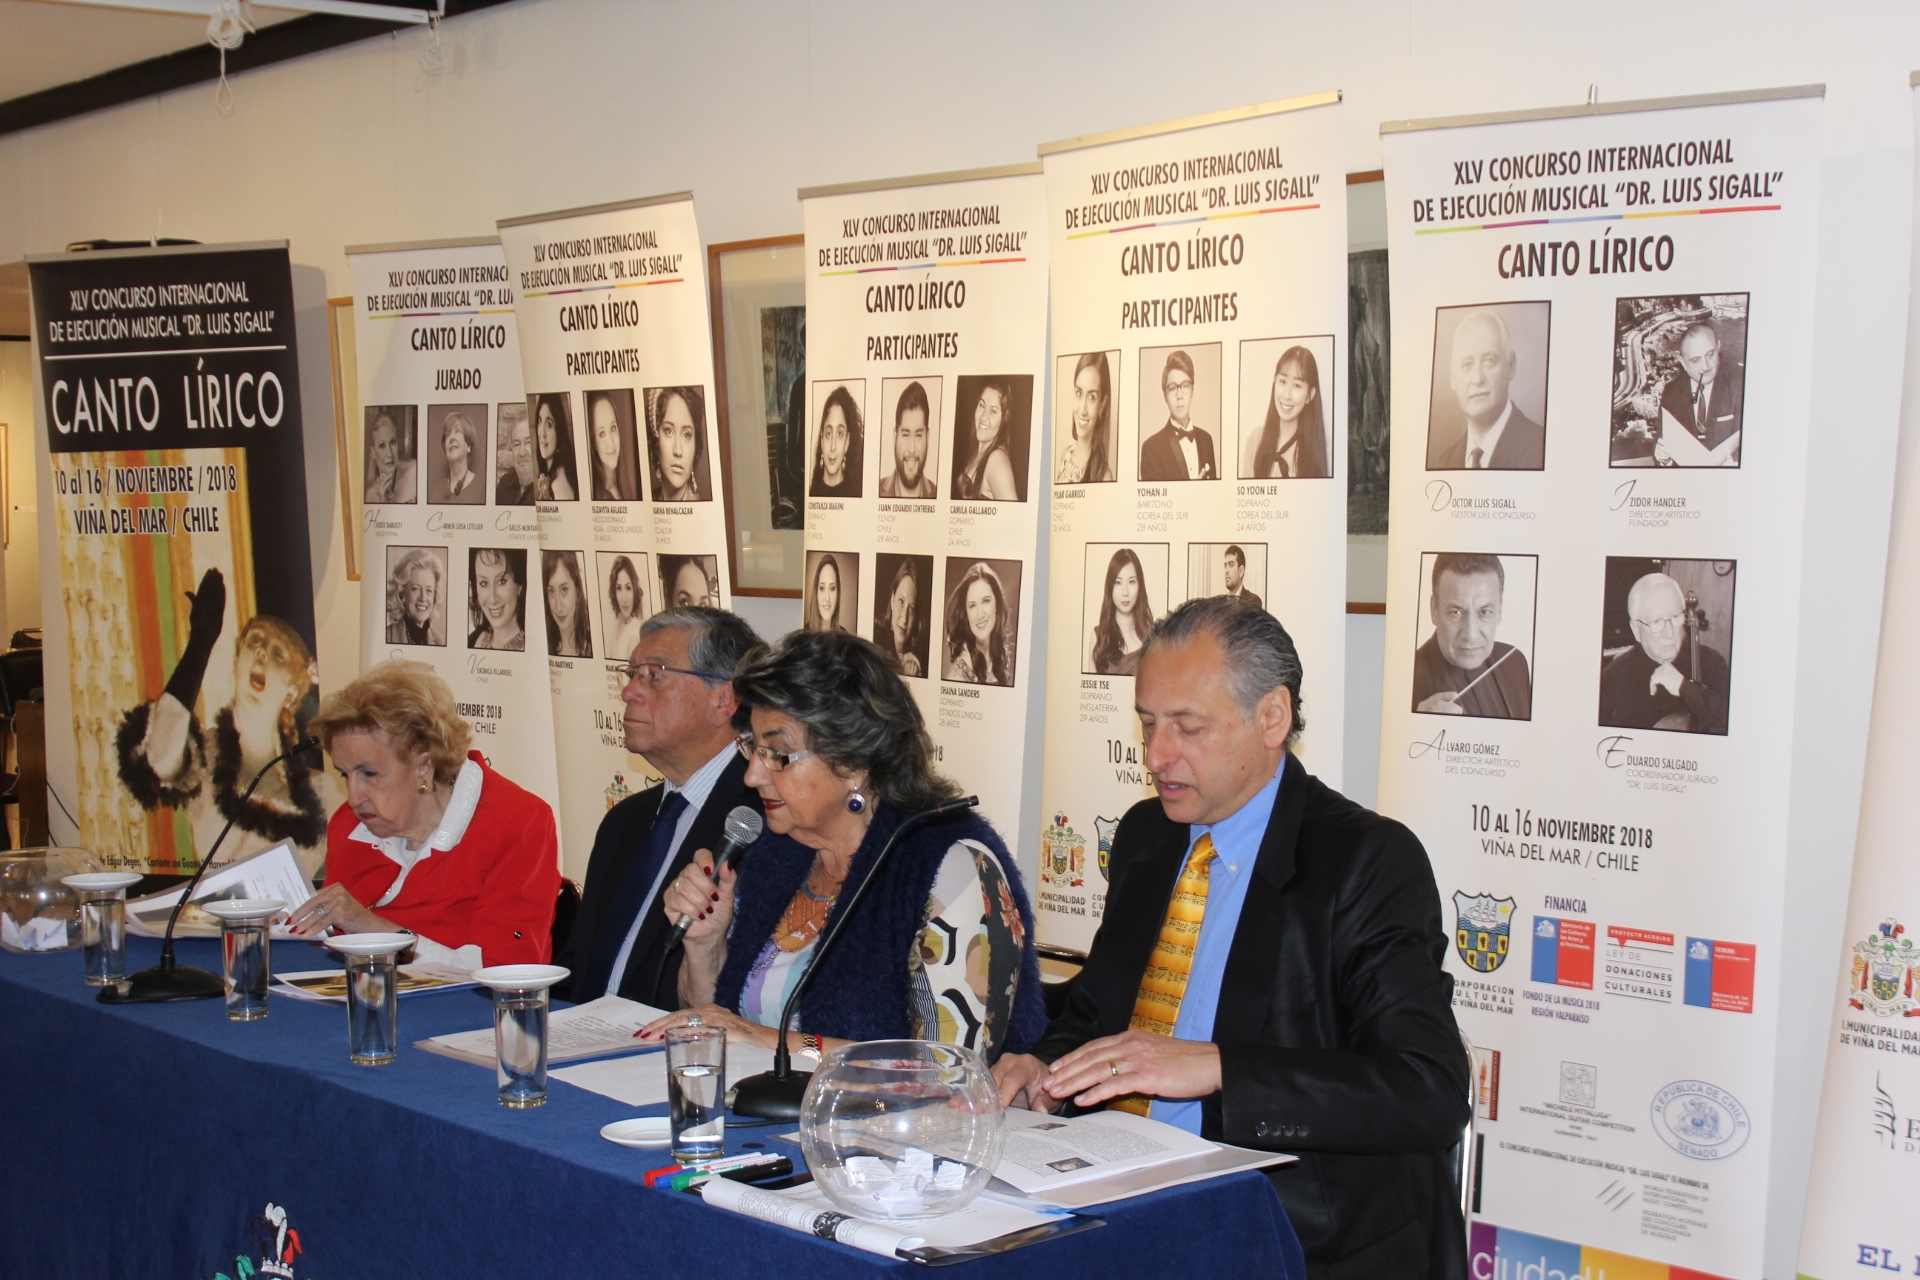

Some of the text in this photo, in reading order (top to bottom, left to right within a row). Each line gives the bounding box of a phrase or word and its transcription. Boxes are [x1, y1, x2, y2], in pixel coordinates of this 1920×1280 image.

[1091, 146, 1283, 196] XLV CONCURSO INTERNACIONAL
[1454, 138, 1734, 185] XLV CONCURSO INTERNACIONAL
[1066, 209, 1079, 229] DE
[1082, 194, 1139, 226] EJECUCIÓN
[1144, 192, 1197, 219] MUSICAL
[1234, 182, 1261, 206] LUIS
[1413, 198, 1434, 222] DE
[1440, 183, 1525, 220] EJECUCIÓN
[1531, 183, 1608, 212] MUSICAL
[1662, 177, 1702, 204] LUIS
[842, 205, 1000, 238] XLV CONCURSO INTERNACIONAL
[534, 230, 657, 263] XLV CONCURSO INTERNACIONAL
[819, 248, 831, 267] DE
[834, 238, 883, 265] EJECUCIÓN
[886, 237, 929, 261] MUSICAL
[959, 234, 982, 256] LUIS
[1121, 228, 1244, 276] CANTO LÍRICO
[1498, 227, 1674, 279] CANTO LÍRICO
[388, 265, 508, 288] XLV CONCURSO INTERNACI
[521, 272, 529, 289] DE
[531, 263, 571, 288] EJECUCIÓN
[573, 263, 608, 284] MUSICAL
[629, 258, 647, 278] LUIS
[70, 281, 248, 311] XLV CONCURSO INTERNACIONAL
[367, 295, 379, 311] DE
[382, 288, 427, 310] EJECUCIÓN
[431, 290, 471, 309] MUSICAL
[498, 288, 513, 305] LUI
[866, 273, 965, 314] CANTO LÍRICO
[560, 294, 639, 332] CANTO LÍRICO
[1122, 291, 1238, 330] PARTICIPANTES
[49, 322, 64, 342] DE
[67, 314, 129, 341] EJECUCIÓN
[132, 318, 181, 338] MUSICAL
[208, 313, 230, 334] LUIS
[411, 319, 505, 351] CANTO LÍRICO
[867, 332, 958, 361] PARTICIPANTES
[566, 348, 640, 376] PARTICIPANTES
[435, 368, 481, 390] JURADO
[52, 357, 284, 434] CANTO LÍRICO
[54, 464, 236, 494] 10 al 16 NOVIEMBRE 2018
[1237, 486, 1277, 495] SO YOON LEE
[1137, 488, 1167, 497] YOHAN JI
[1474, 498, 1490, 508] LUIS
[1492, 498, 1516, 508] SIGALL
[1653, 498, 1686, 507] HANDLER
[74, 503, 219, 534] VIÑA DEL MAR CHILE
[1493, 512, 1536, 520] CONCURSO
[1628, 519, 1669, 527] FUNDADOR
[1099, 681, 1110, 690] TSE
[486, 705, 502, 718] 2018
[594, 710, 603, 729] 10
[606, 717, 613, 730] AL
[475, 722, 496, 734] CHILE
[601, 732, 616, 746] VIÑA
[1107, 739, 1137, 764] 10 AL
[1473, 742, 1500, 755] GÓMEZ
[1115, 767, 1143, 785] VIÑA
[1461, 766, 1505, 777] CONCURSO
[1626, 768, 1718, 784] COORDINADOR JURADO
[1662, 758, 1697, 771] SALGADO
[1472, 804, 1652, 848] 10 AL 16 NOVIEMBRE 2018
[107, 855, 122, 867] Edgar
[1481, 836, 1639, 872] VIÑA DEL MAR CHILE
[1545, 895, 1586, 913] FINANCIA
[1607, 949, 1641, 960] LEY DE
[1606, 965, 1672, 982] DONACIONES
[1523, 990, 1543, 1001] FONDO
[1545, 994, 1552, 1003] DE
[1554, 995, 1560, 1004] LA
[1585, 999, 1600, 1010] 2018
[1605, 981, 1671, 998] CULTURALES
[1480, 1002, 1494, 1012] DEL
[1497, 1005, 1513, 1015] MAR
[1531, 1006, 1554, 1018] REGIÓN
[1840, 1033, 1897, 1052] DE VIÑA DEL
[1706, 1086, 1719, 1099] DE
[1721, 1096, 1746, 1128] CHILE
[1678, 1142, 1717, 1157] SENADO
[1856, 1243, 1901, 1272] EL
